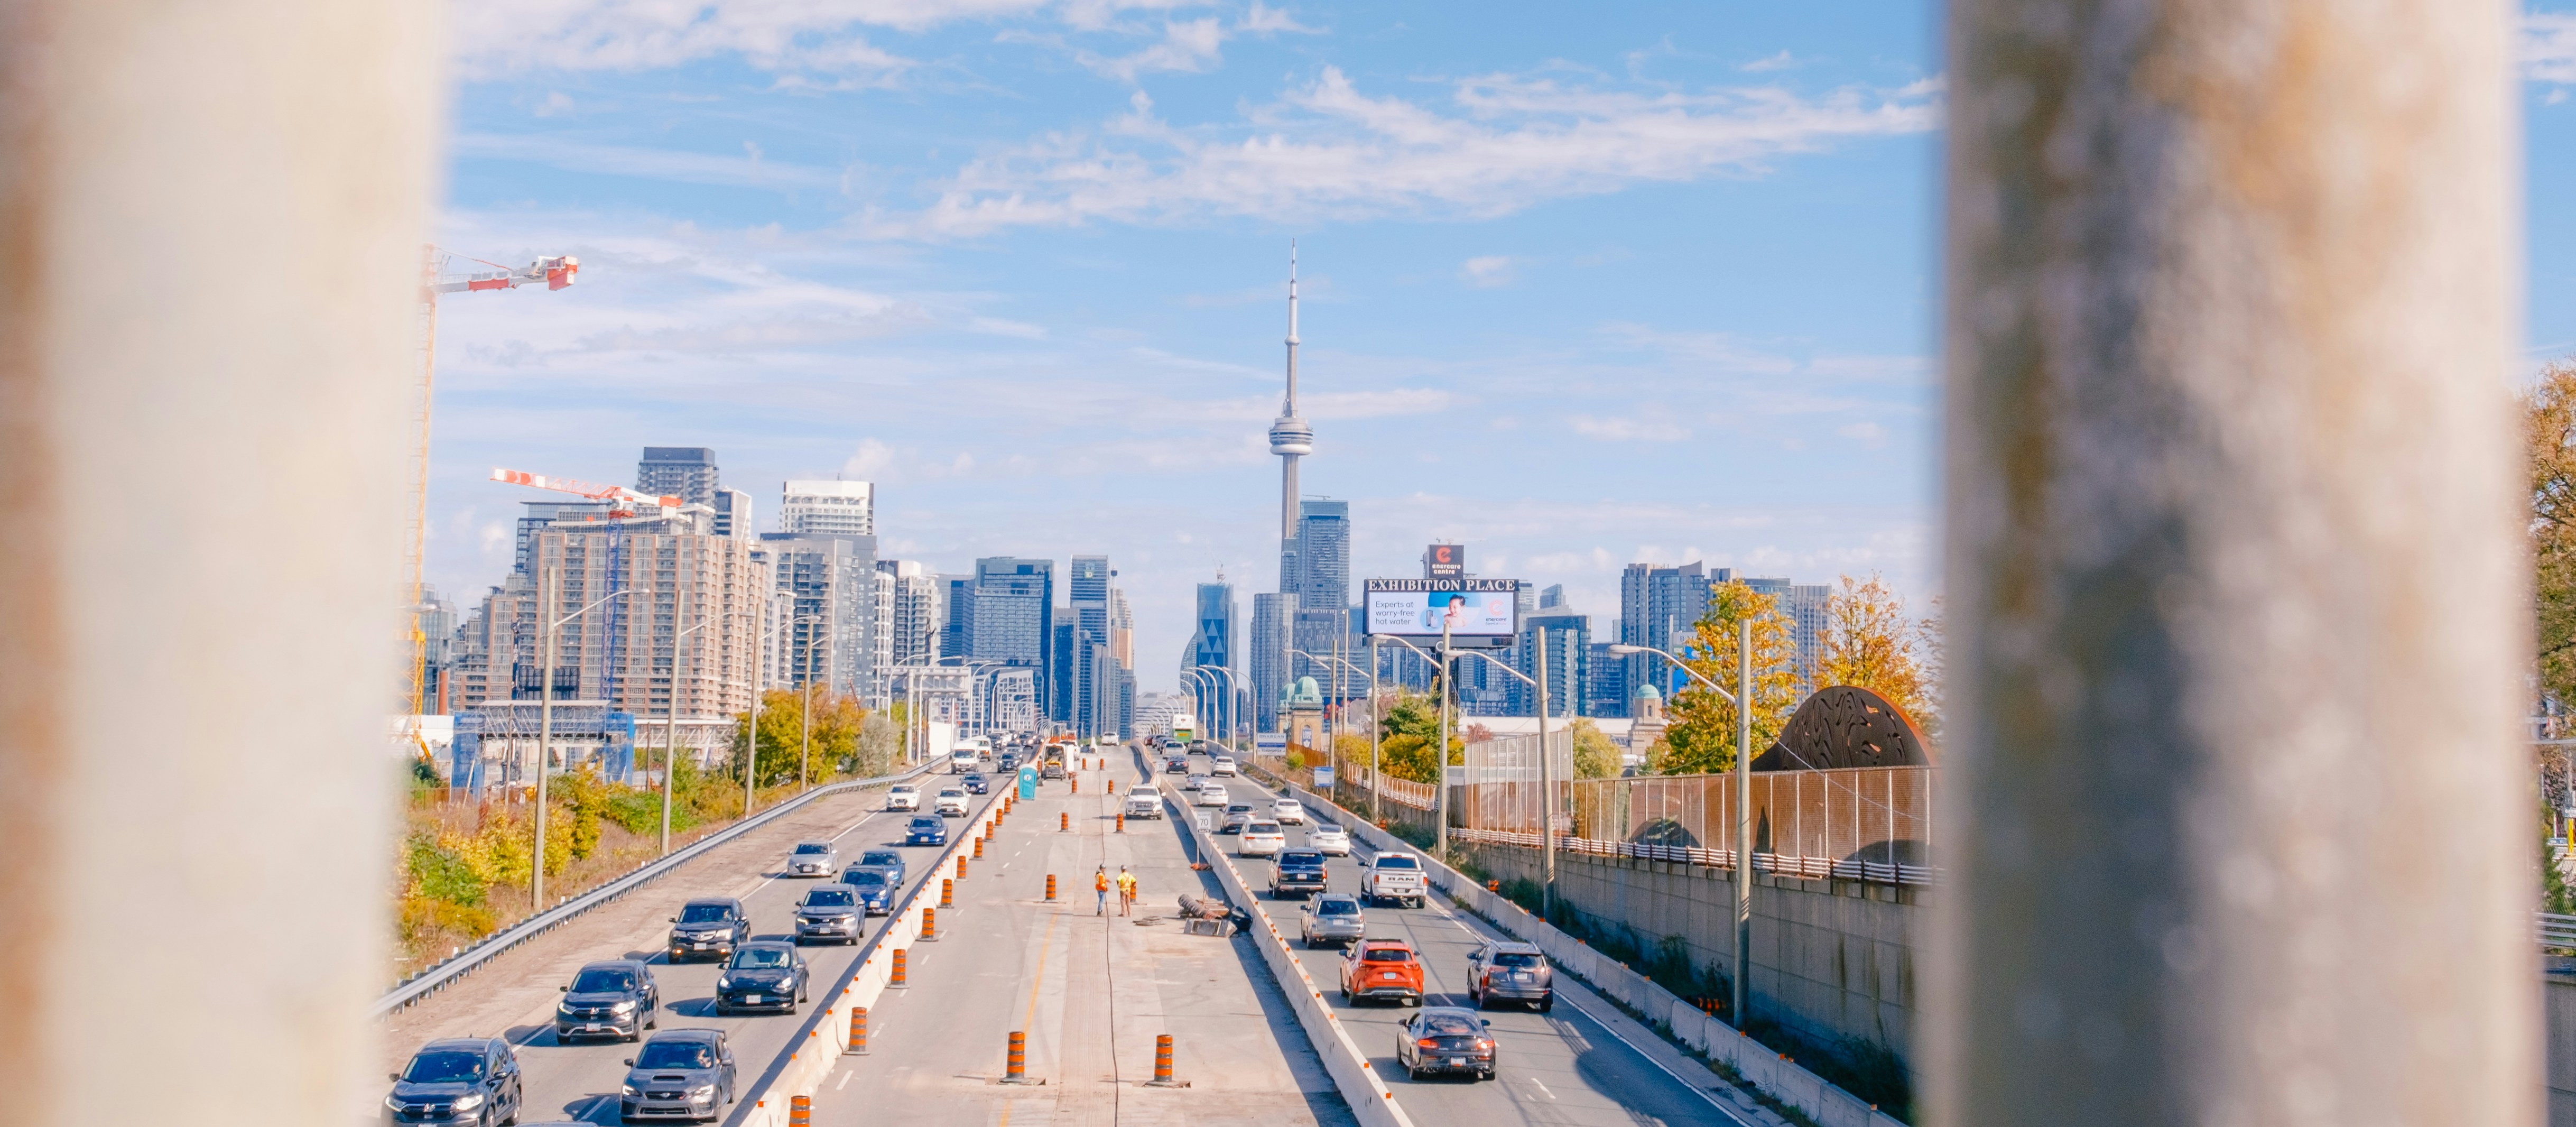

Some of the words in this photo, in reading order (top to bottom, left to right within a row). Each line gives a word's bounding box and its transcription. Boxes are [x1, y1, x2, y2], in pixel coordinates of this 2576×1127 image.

[1368, 579, 1460, 591] EXHIBITION
[1466, 580, 1515, 591] PLACE
[1375, 601, 1404, 609] Experts
